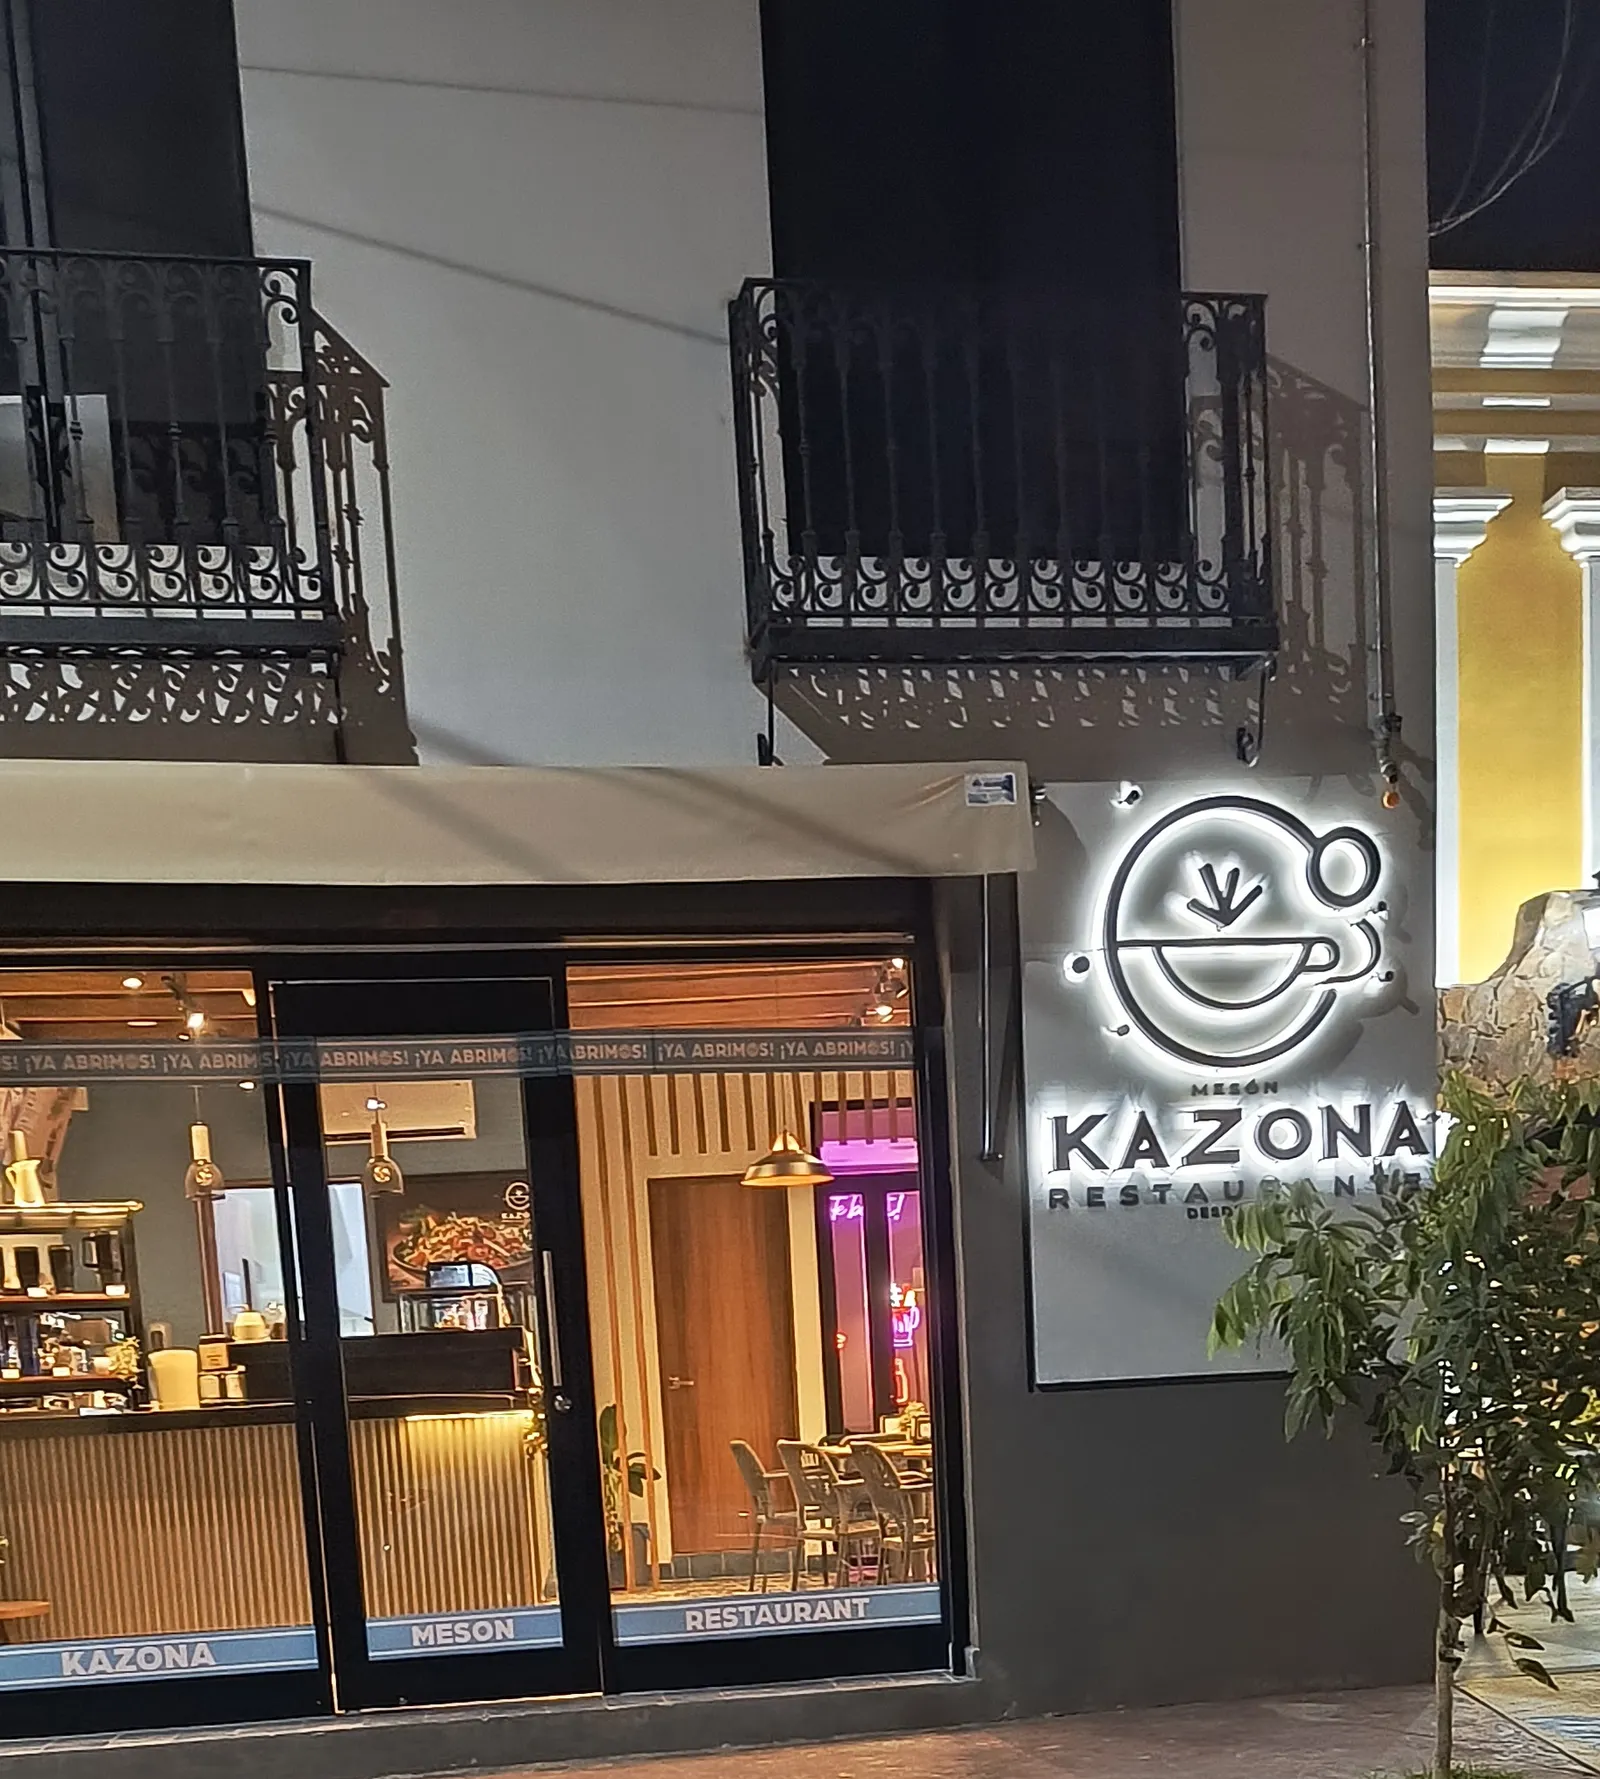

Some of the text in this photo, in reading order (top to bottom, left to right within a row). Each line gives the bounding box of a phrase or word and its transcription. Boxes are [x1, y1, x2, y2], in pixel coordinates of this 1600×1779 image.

[25, 1055, 56, 1074] ¡YA
[164, 1053, 194, 1073] ¡YA
[416, 1049, 444, 1068] ¡YA
[569, 1044, 647, 1060] BRIMOS!
[658, 1043, 686, 1062] ¡YA
[780, 1042, 808, 1060] ¡YA
[1191, 1079, 1279, 1097] MESÓN
[1048, 1100, 1429, 1172] KAZONA
[1048, 1171, 1422, 1210] RESTAURNTE
[1187, 1204, 1239, 1220] DESD
[684, 1597, 870, 1632] RESTAURANT
[411, 1618, 516, 1647] MESON
[61, 1642, 217, 1677] KAZONA
